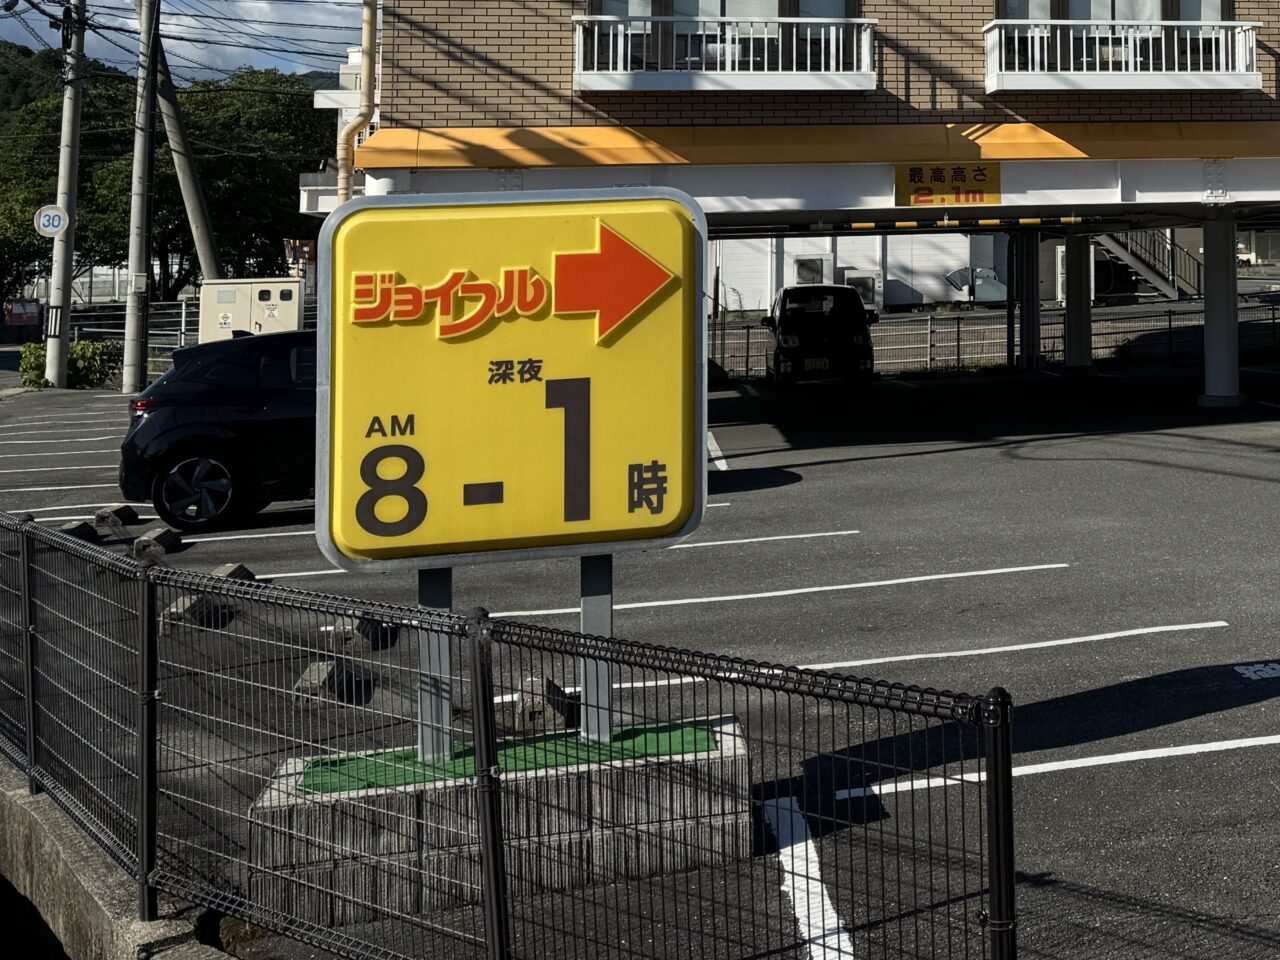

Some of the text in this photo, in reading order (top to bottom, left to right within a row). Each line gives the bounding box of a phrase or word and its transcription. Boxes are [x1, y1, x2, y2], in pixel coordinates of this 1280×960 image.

[908, 166, 988, 184] 最高高さ
[913, 186, 985, 204] 2.1m
[42, 214, 61, 228] 30
[351, 267, 546, 339] ジョイフル
[488, 358, 543, 384] 深夜
[365, 414, 415, 439] AM
[628, 460, 667, 515] 時
